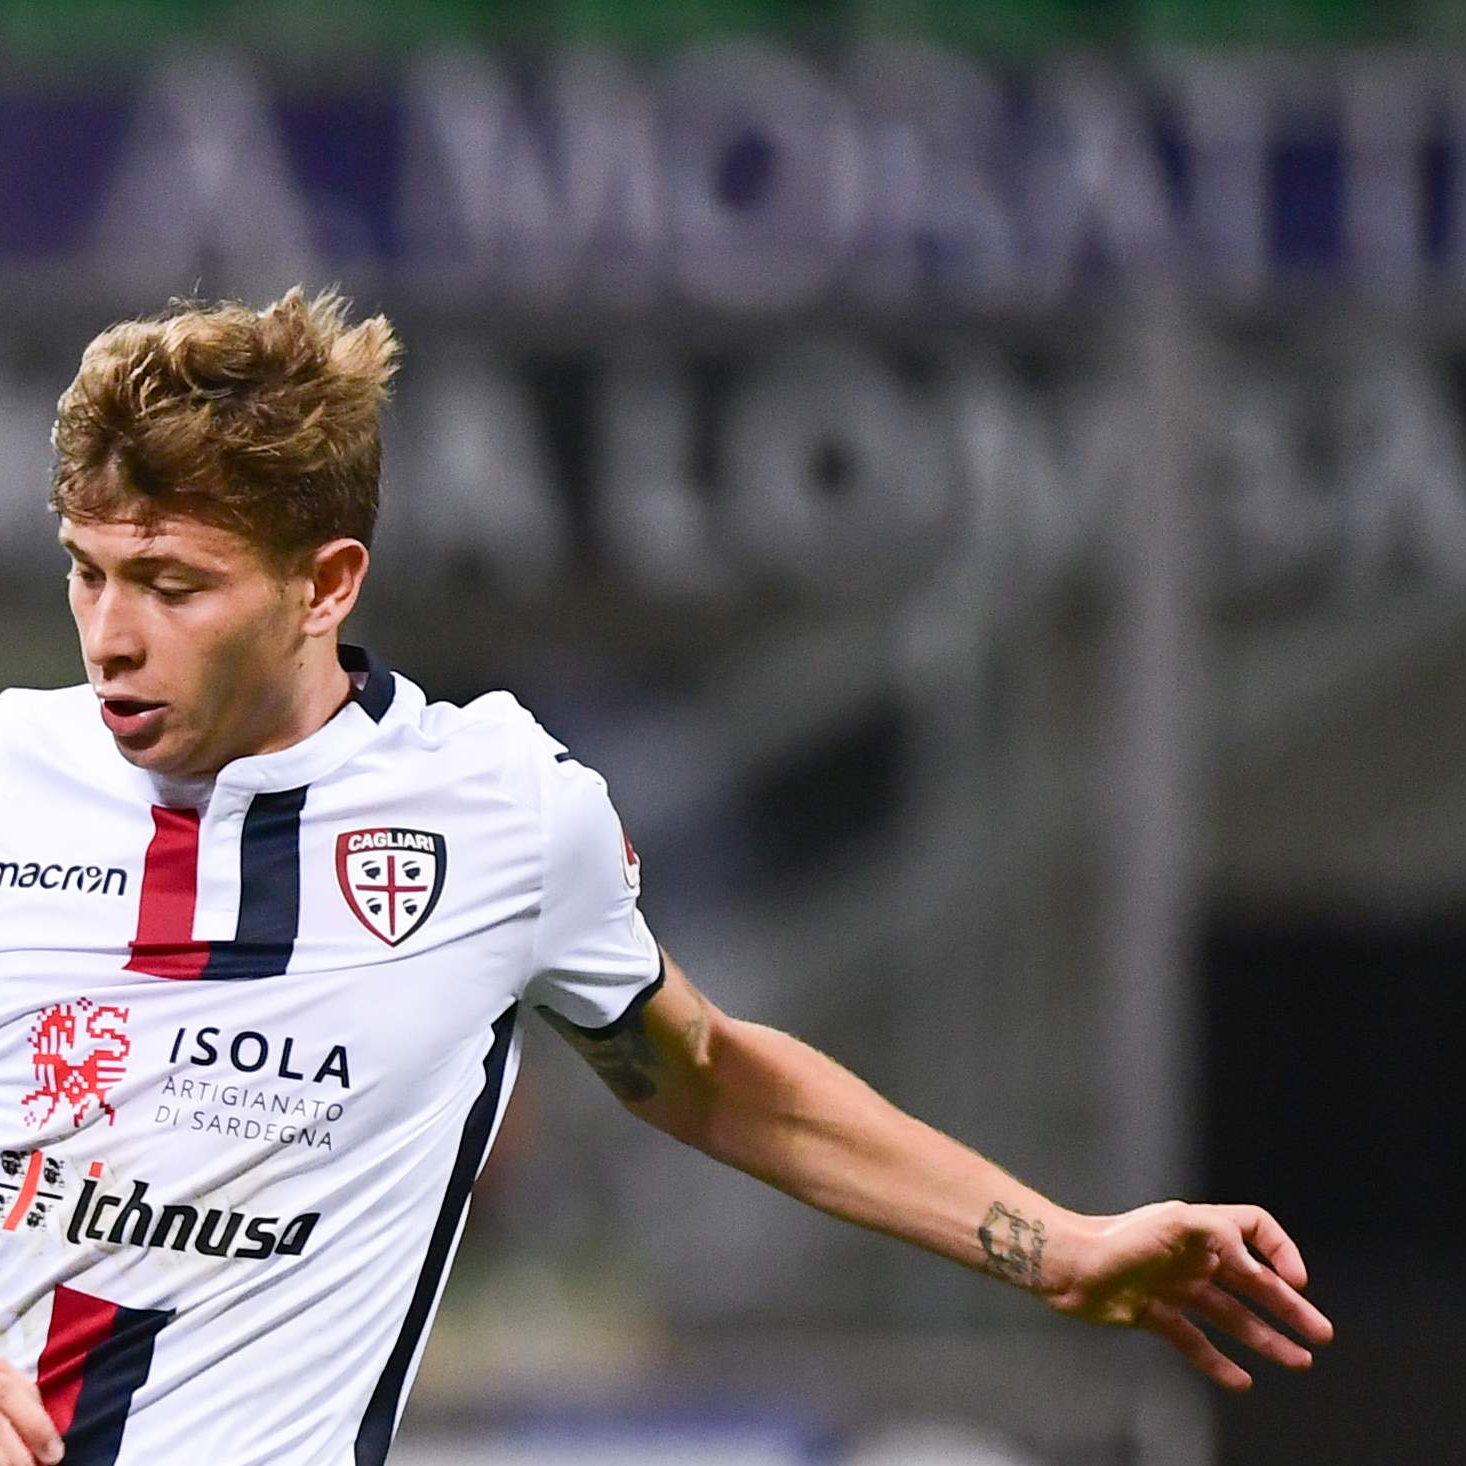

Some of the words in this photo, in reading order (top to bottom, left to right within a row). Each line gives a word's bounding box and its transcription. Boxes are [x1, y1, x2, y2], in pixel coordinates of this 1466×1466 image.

[347, 832, 436, 852] CAGLIARI
[168, 1026, 351, 1089] ISOLA
[162, 1076, 343, 1122] ARTIGIANATO
[154, 1105, 181, 1127] DI
[190, 1111, 333, 1151] SARDEGNA
